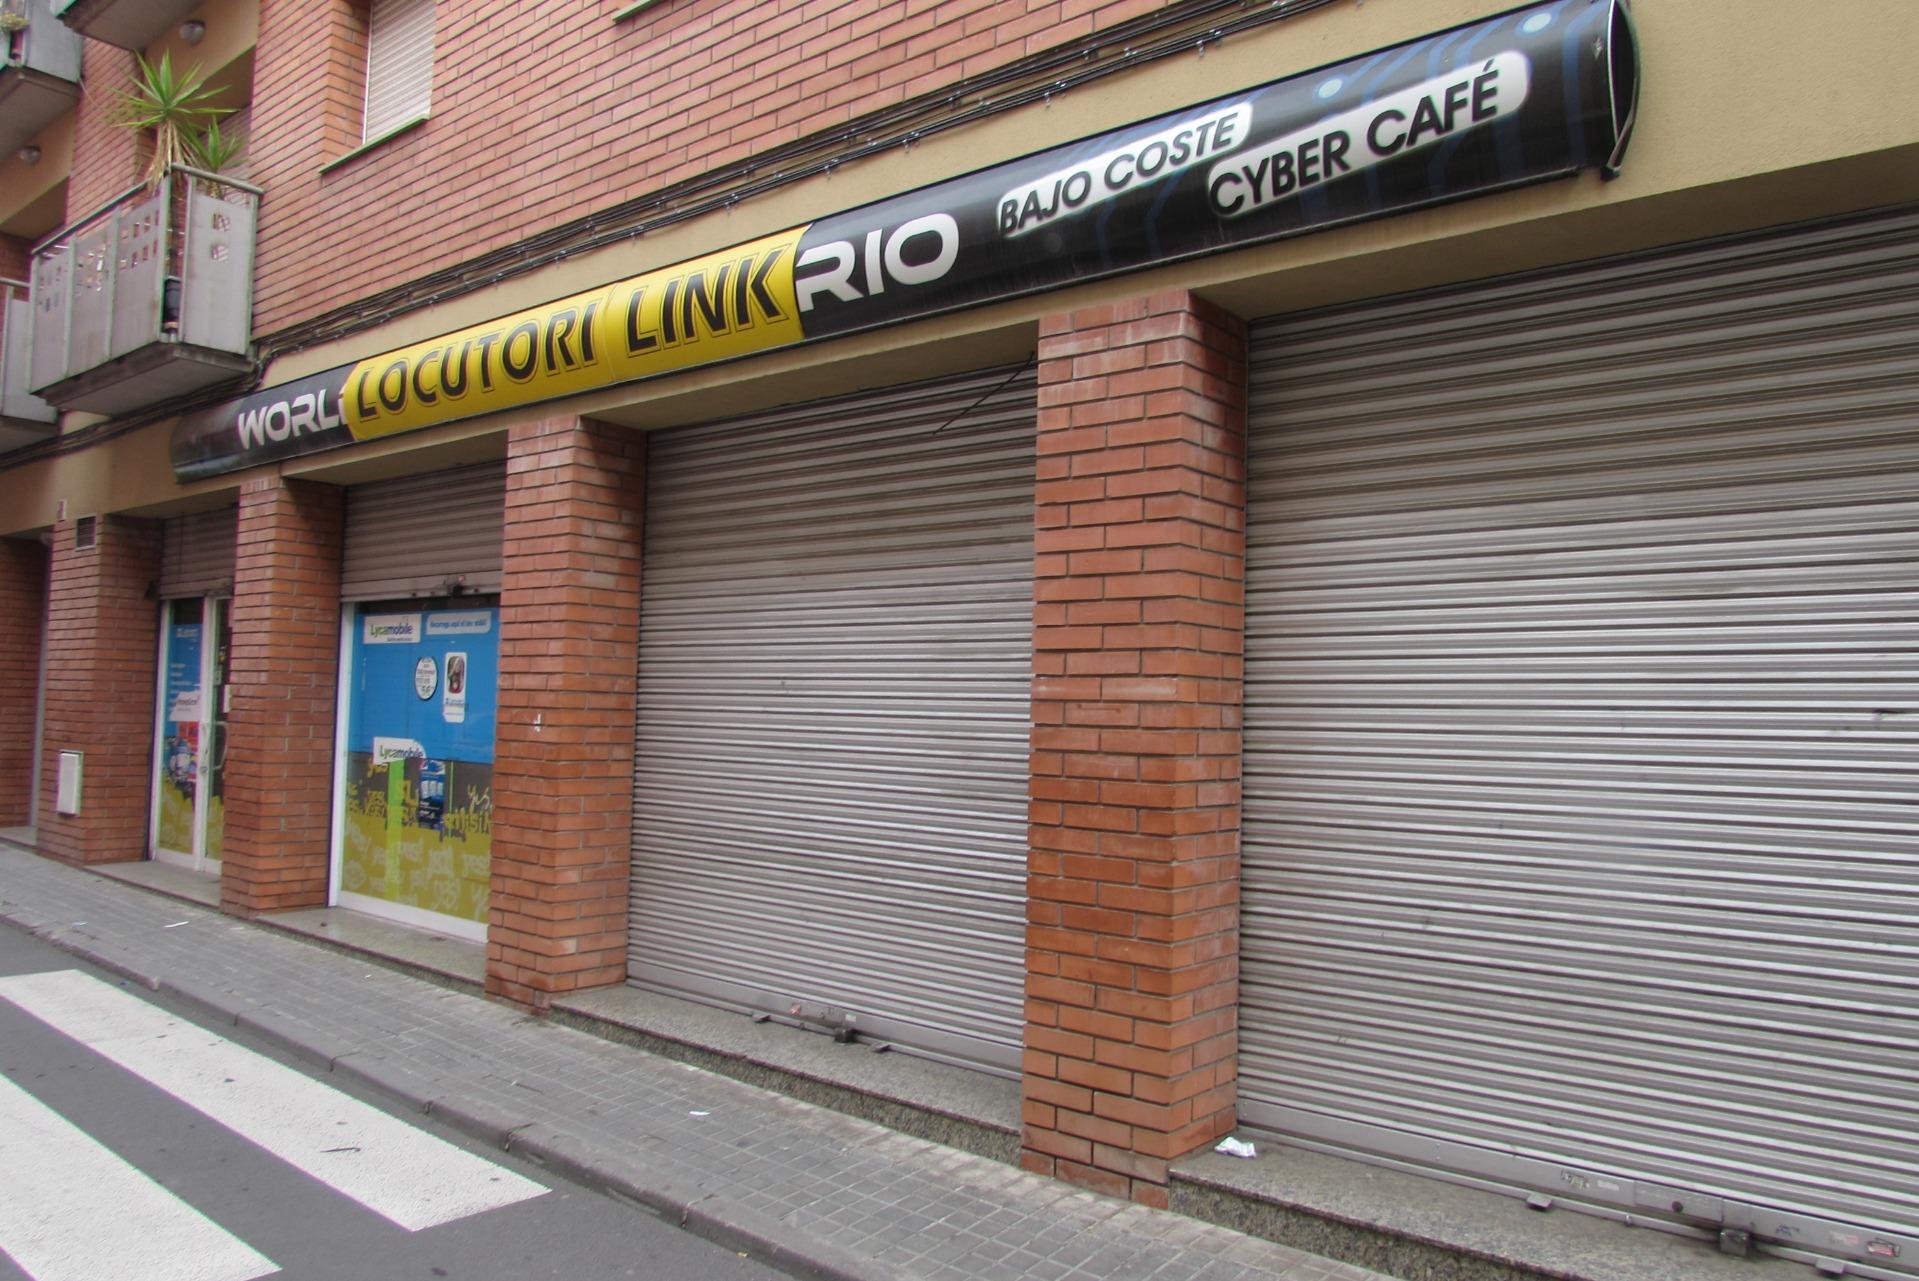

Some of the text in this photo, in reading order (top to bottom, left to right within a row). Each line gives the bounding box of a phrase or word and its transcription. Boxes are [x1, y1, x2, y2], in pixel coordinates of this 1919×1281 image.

[1000, 112, 1238, 236] BAJO COSTE
[1210, 59, 1499, 214] CYBER CAFÉ
[795, 213, 959, 312] RIO
[356, 247, 788, 420] LOCUTORI LINK
[238, 389, 348, 449] WORL
[370, 623, 414, 638] Lycamobile
[380, 745, 424, 759] Lycamobile
